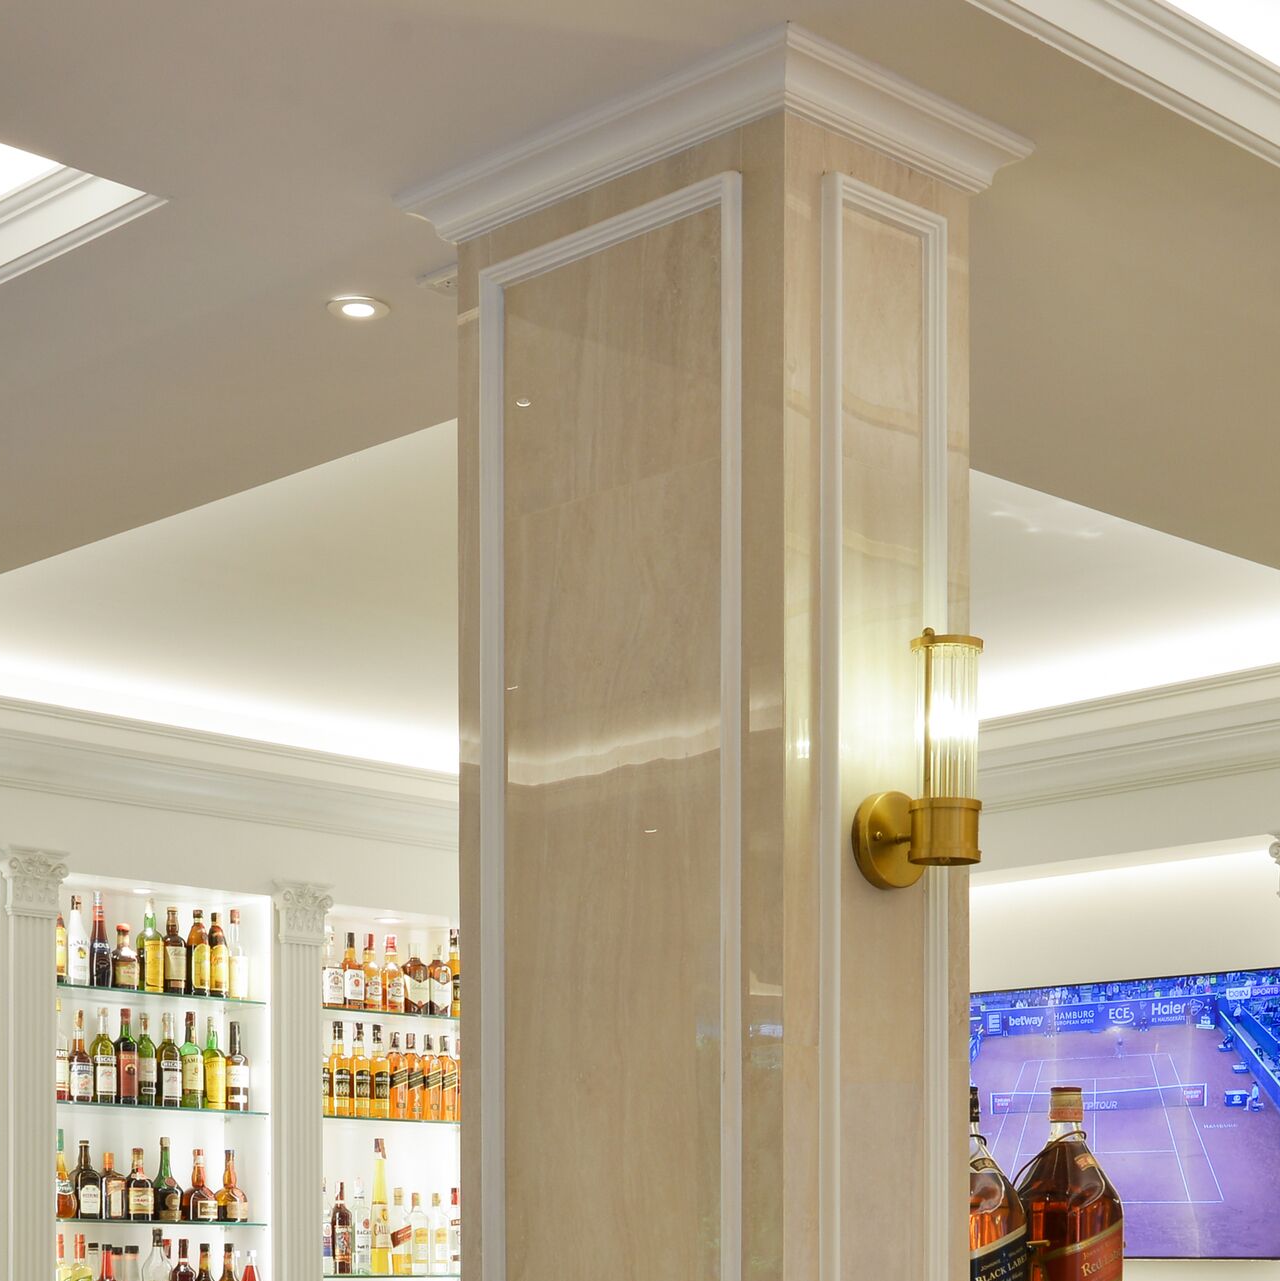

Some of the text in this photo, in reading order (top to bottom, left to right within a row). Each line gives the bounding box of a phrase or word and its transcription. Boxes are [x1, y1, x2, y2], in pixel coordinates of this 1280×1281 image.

[1252, 987, 1279, 996] SPORTS
[1108, 1007, 1131, 1019] ECE
[1151, 1001, 1186, 1016] Haier
[1054, 1010, 1095, 1021] HAMBURG
[1008, 1015, 1044, 1028] betway
[1080, 1018, 1094, 1026] OPEN
[1095, 1100, 1118, 1110] TOUR
[1080, 1258, 1103, 1277] Red
